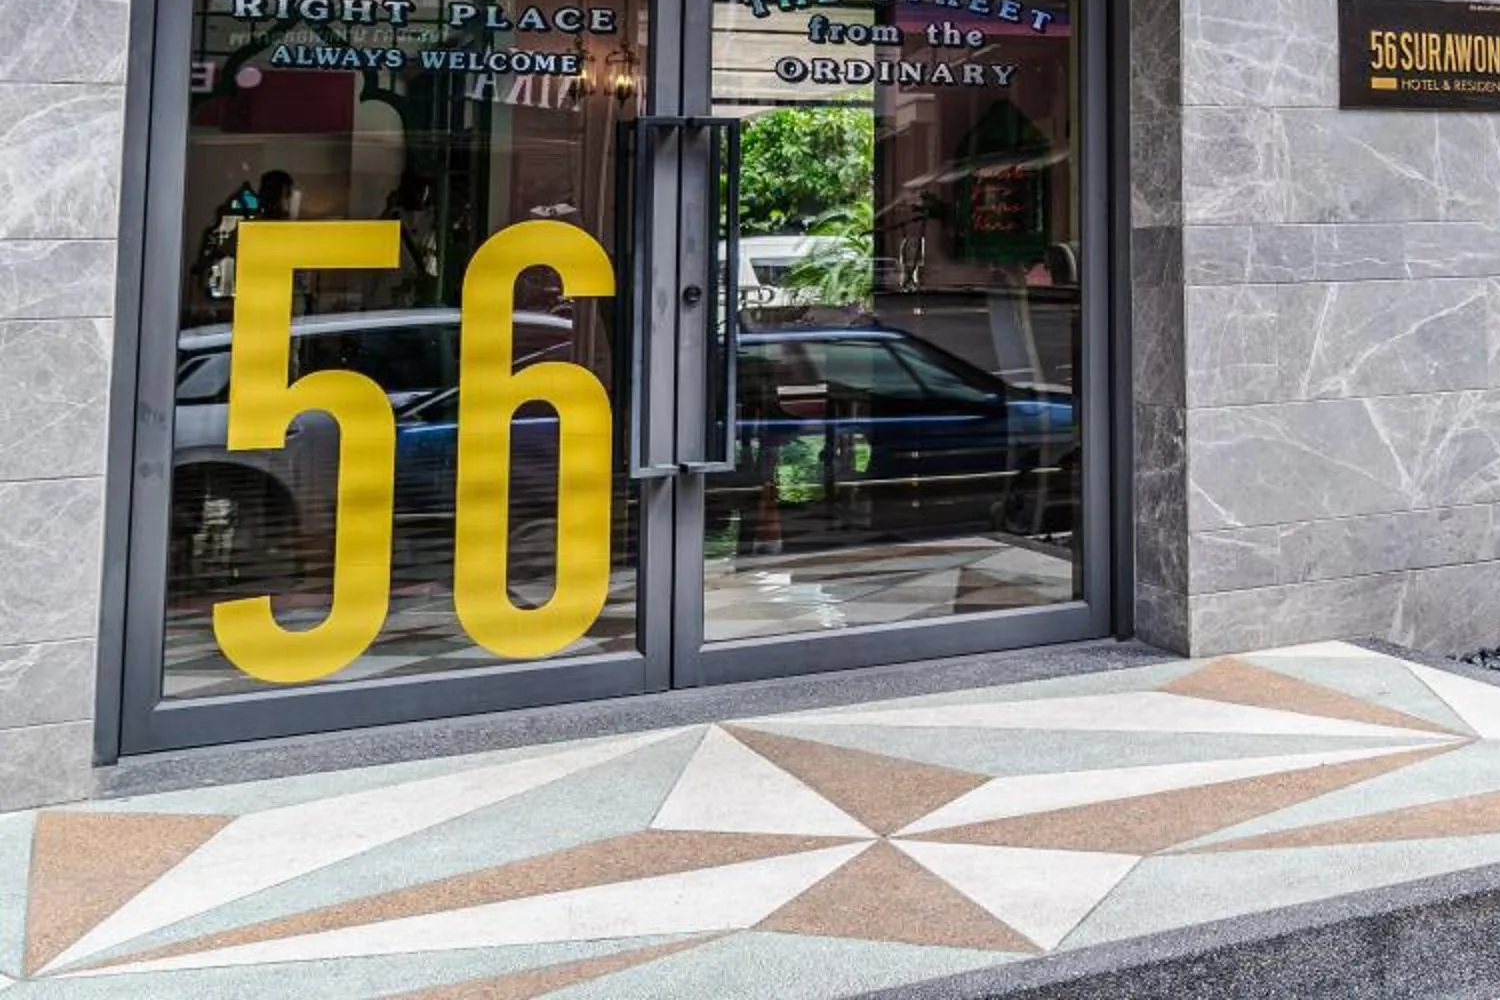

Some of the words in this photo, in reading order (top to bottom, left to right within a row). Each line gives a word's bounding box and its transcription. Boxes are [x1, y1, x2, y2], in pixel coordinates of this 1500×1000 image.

[448, 2, 618, 34] PLACE
[808, 13, 903, 44] from
[926, 21, 986, 48] the
[270, 44, 405, 70] ALWAYS
[420, 49, 581, 76] WELCOME
[776, 55, 1018, 87] ORDINARY
[1402, 79, 1440, 91] HOTEL
[1442, 80, 1450, 91] &
[213, 220, 615, 684] 56
